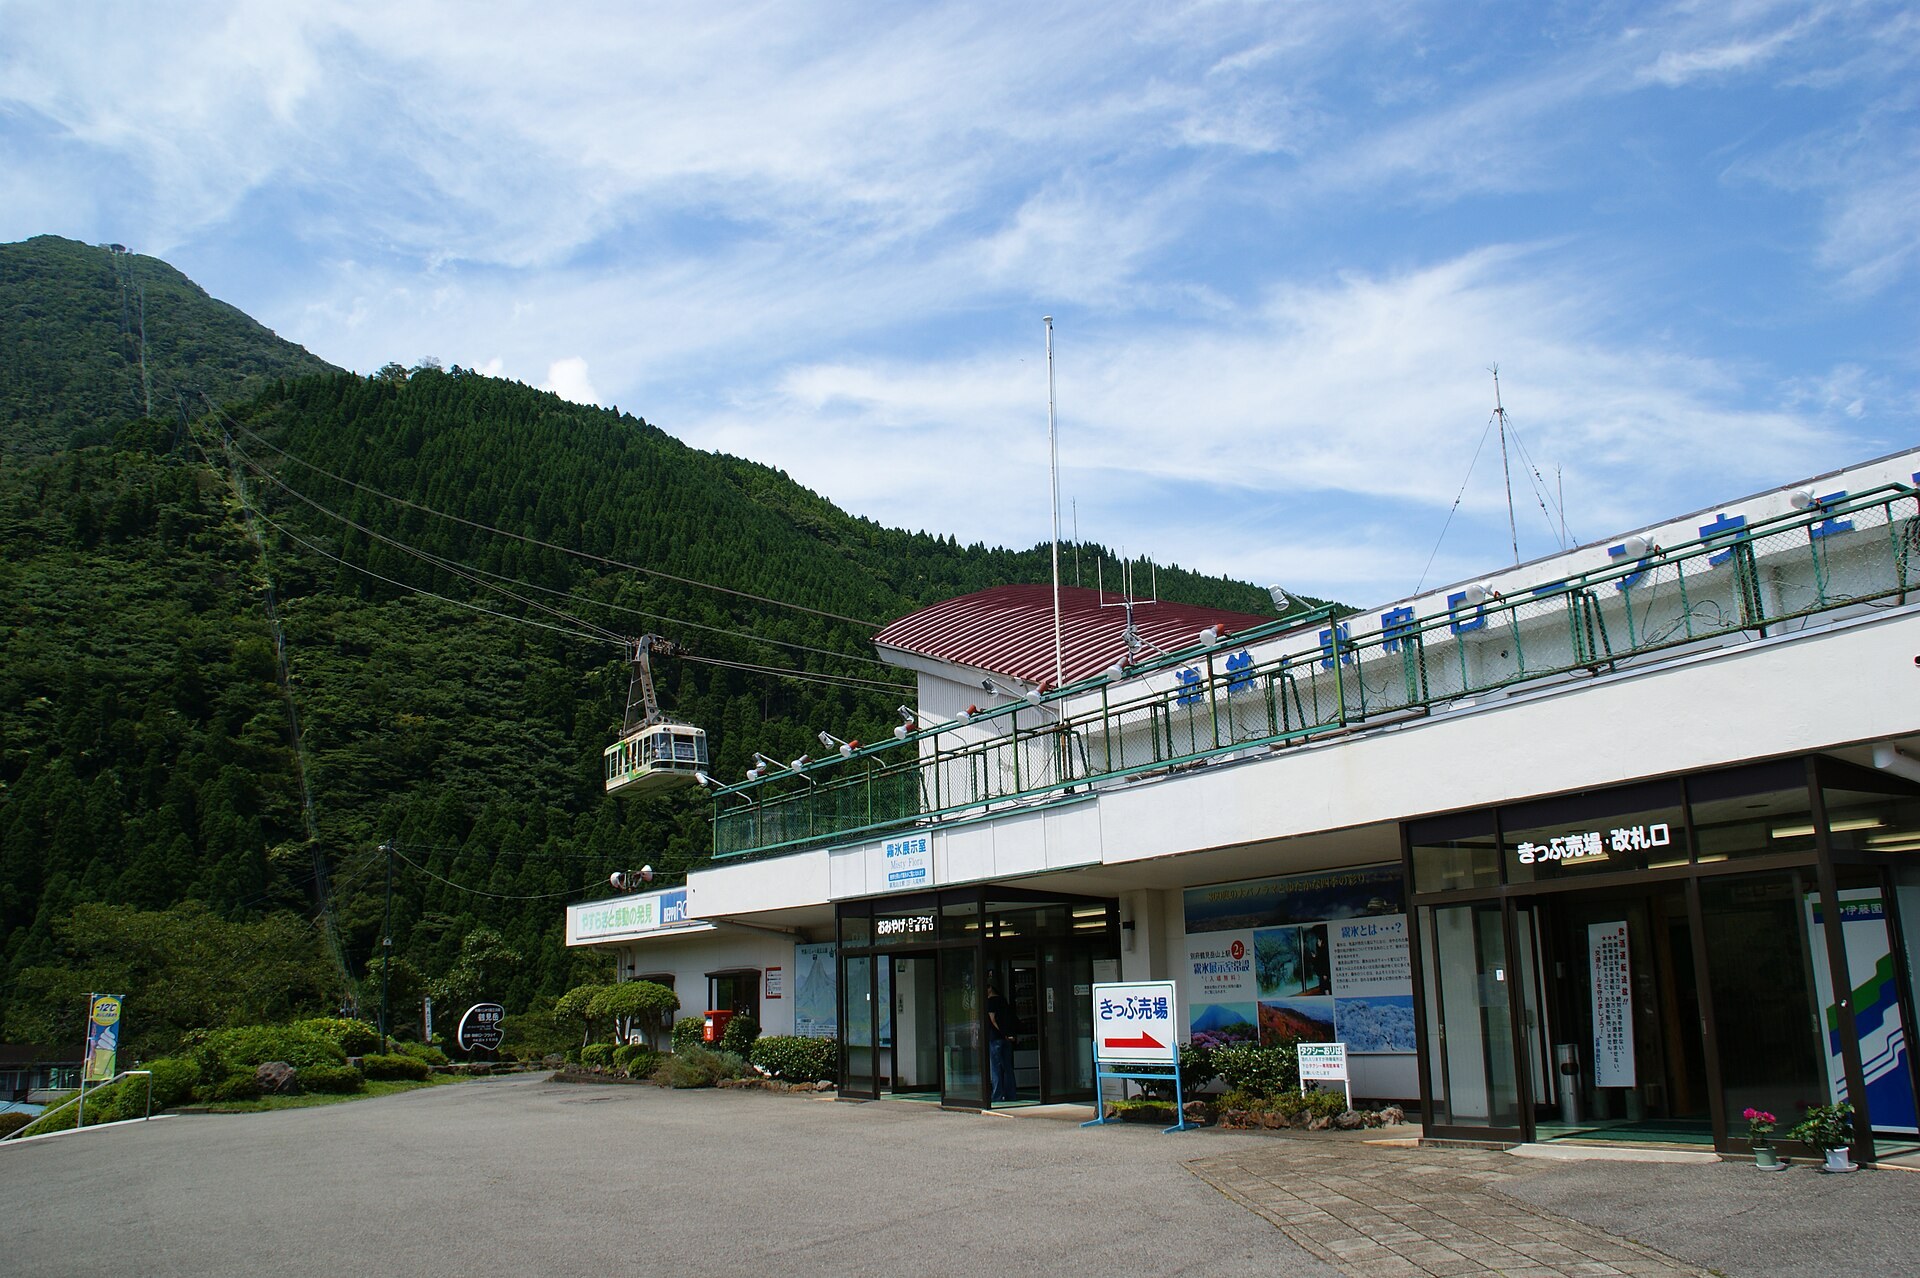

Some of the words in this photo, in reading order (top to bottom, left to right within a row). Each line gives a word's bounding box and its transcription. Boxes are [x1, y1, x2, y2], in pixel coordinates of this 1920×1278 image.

[887, 838, 926, 858] 霧氷展示室
[1517, 823, 1670, 864] きっぷ売場・改札口
[1845, 903, 1882, 915] 伊藤園
[1100, 996, 1168, 1020] きっぷ売場
